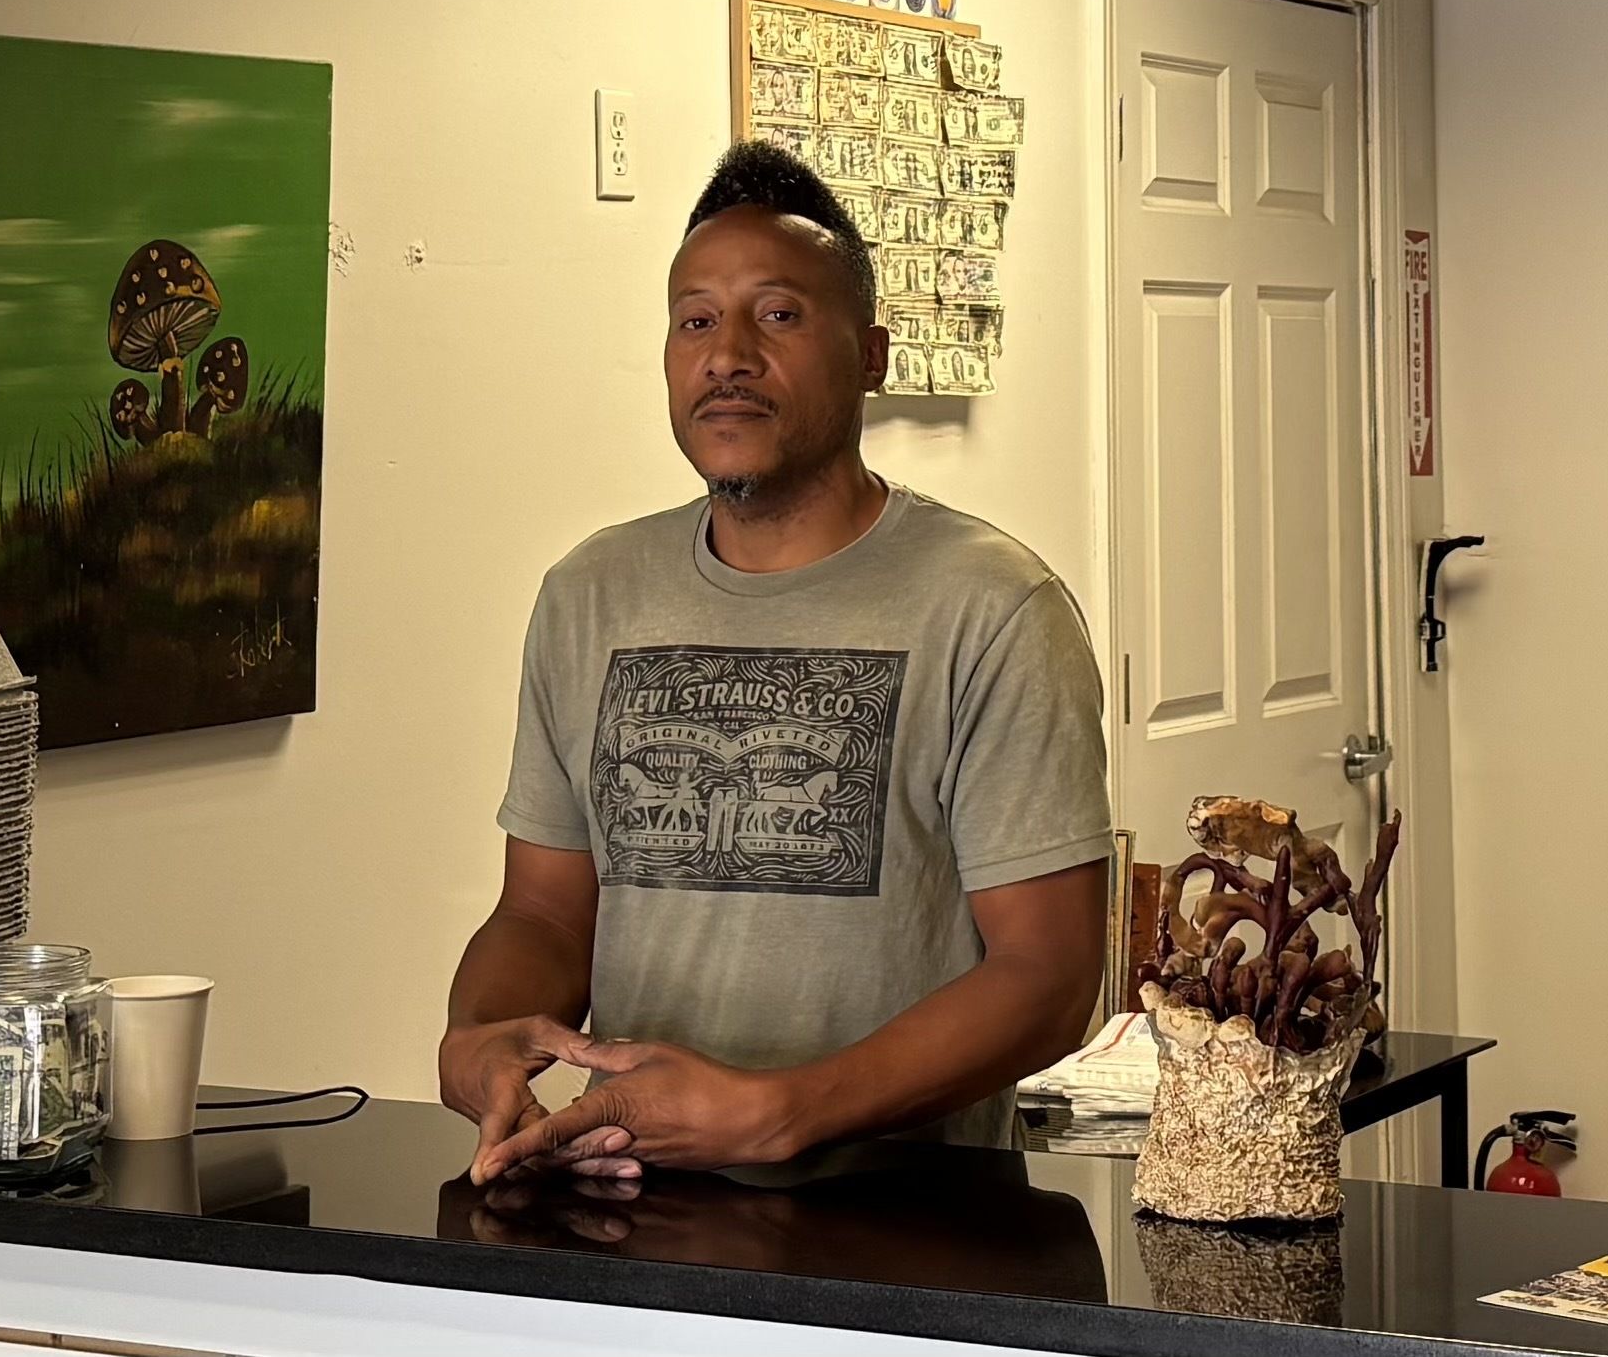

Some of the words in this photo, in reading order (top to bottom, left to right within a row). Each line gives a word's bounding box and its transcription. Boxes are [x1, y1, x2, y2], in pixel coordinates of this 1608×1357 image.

[1405, 249, 1427, 281] FIRE
[1412, 283, 1422, 457] EXTINGUISHER
[623, 688, 670, 714] LEVI
[679, 681, 789, 713] STRAUSS
[793, 692, 812, 714] &
[818, 692, 860, 718] CO.
[625, 728, 722, 750] ORIGINAL
[739, 729, 831, 752] RIVETED
[646, 752, 700, 768] QUALITY
[749, 753, 807, 770] CLOTHING
[828, 806, 851, 823] XX
